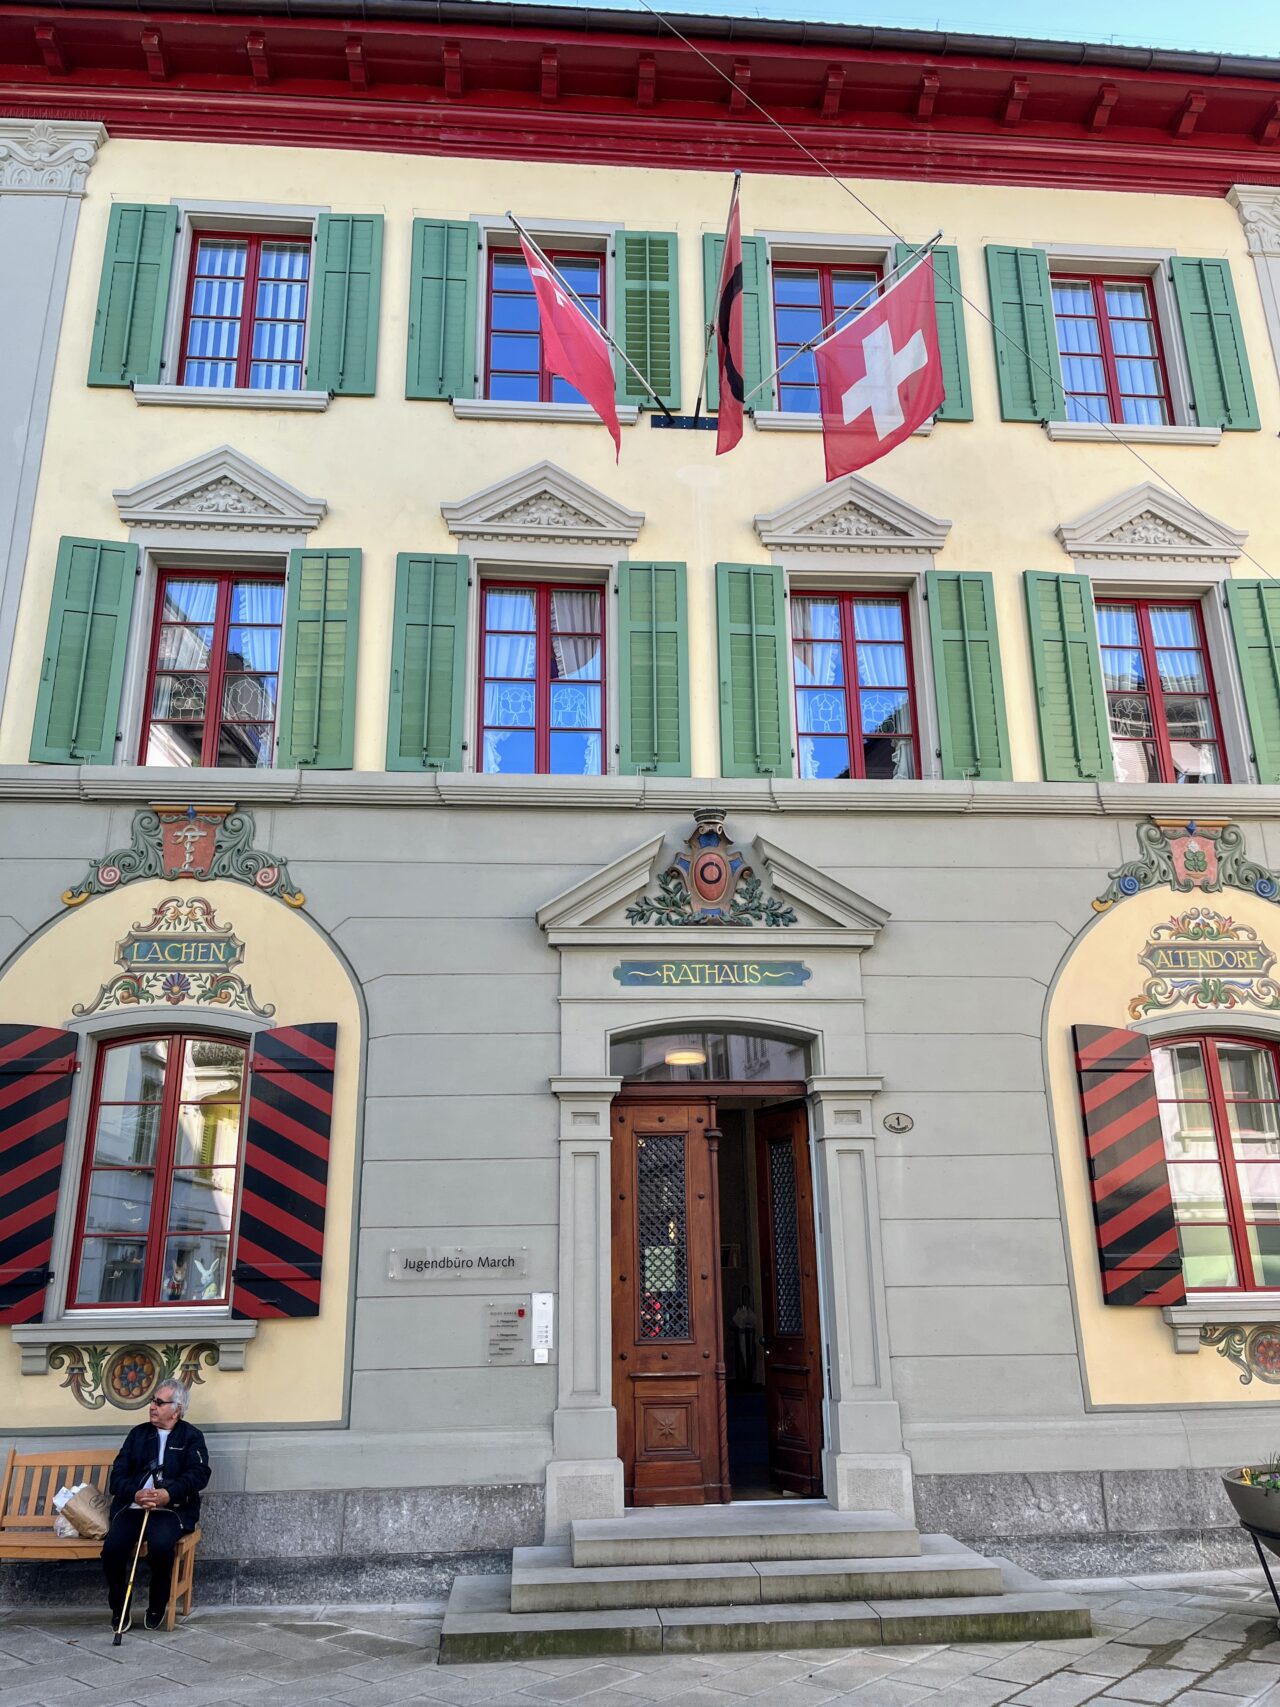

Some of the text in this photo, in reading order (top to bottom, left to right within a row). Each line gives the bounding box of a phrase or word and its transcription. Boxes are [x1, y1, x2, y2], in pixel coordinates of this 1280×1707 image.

[131, 942, 226, 962] LACHEN
[1156, 950, 1258, 969] ALTENDORF
[661, 964, 761, 984] RATHAUS
[895, 1115, 901, 1126] 1
[403, 1255, 515, 1272] Jugendbüro March
